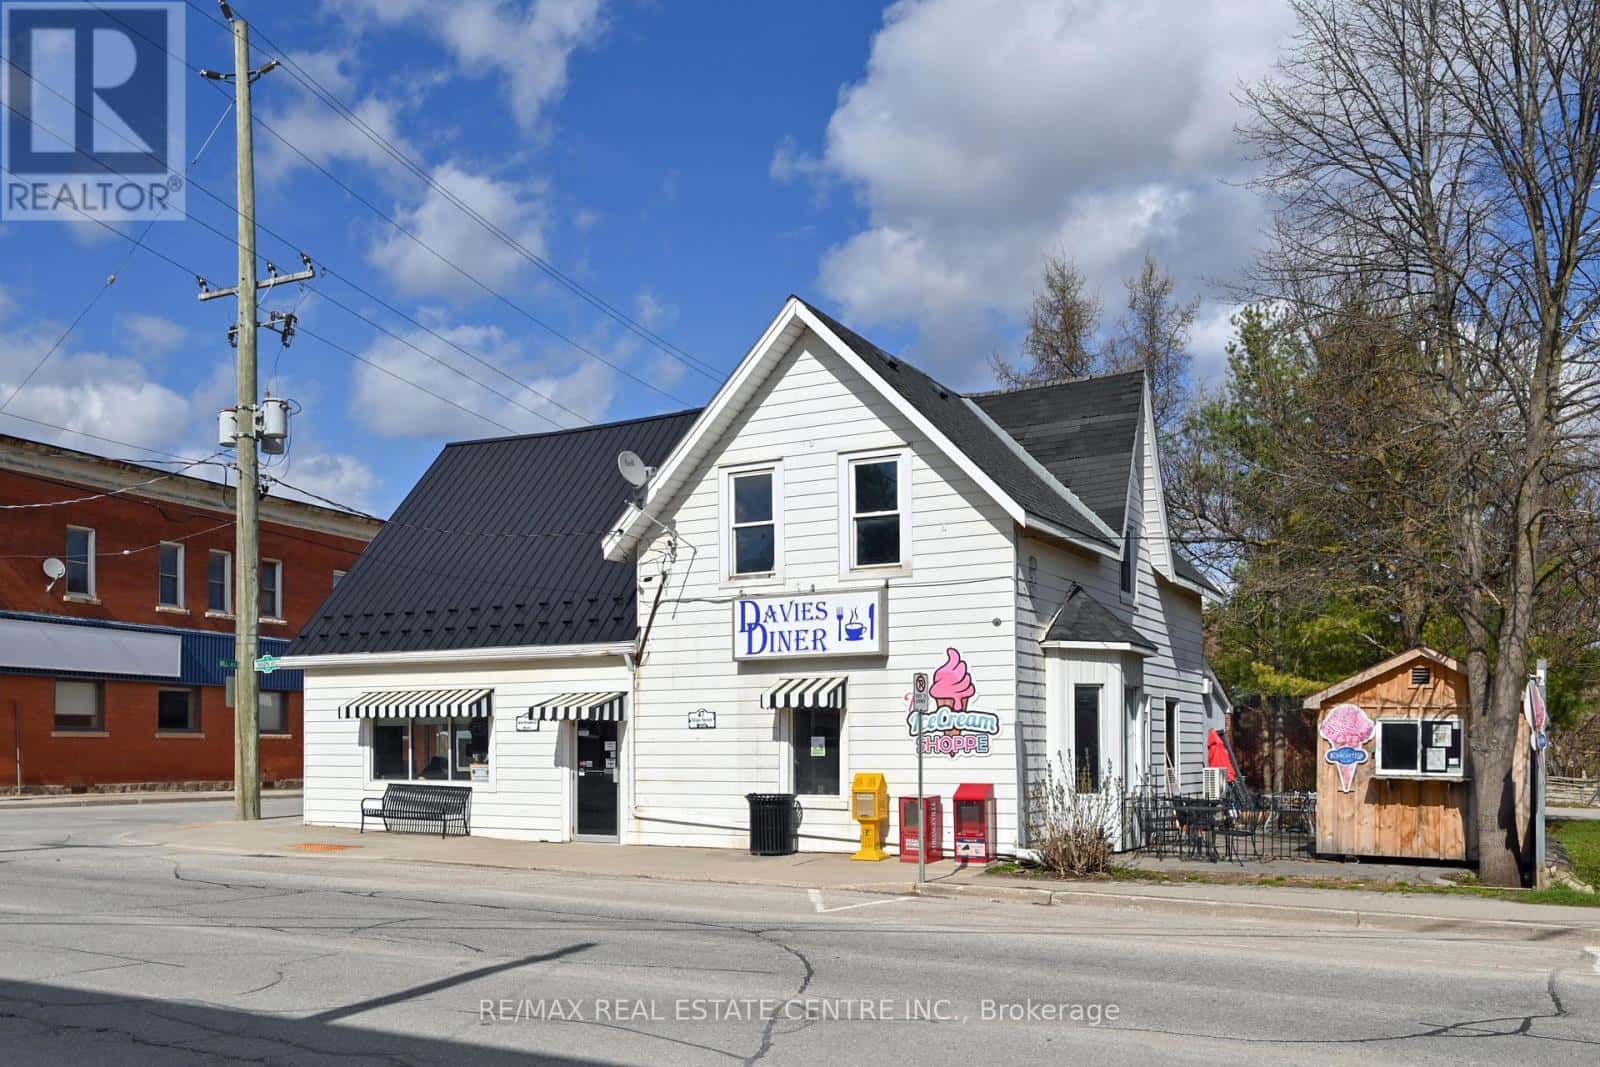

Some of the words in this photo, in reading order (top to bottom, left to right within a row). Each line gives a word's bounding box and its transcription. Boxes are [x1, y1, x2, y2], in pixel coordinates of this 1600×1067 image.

[739, 600, 828, 633] DAVIES
[746, 622, 827, 655] DINER
[916, 734, 989, 754] SHOPPE
